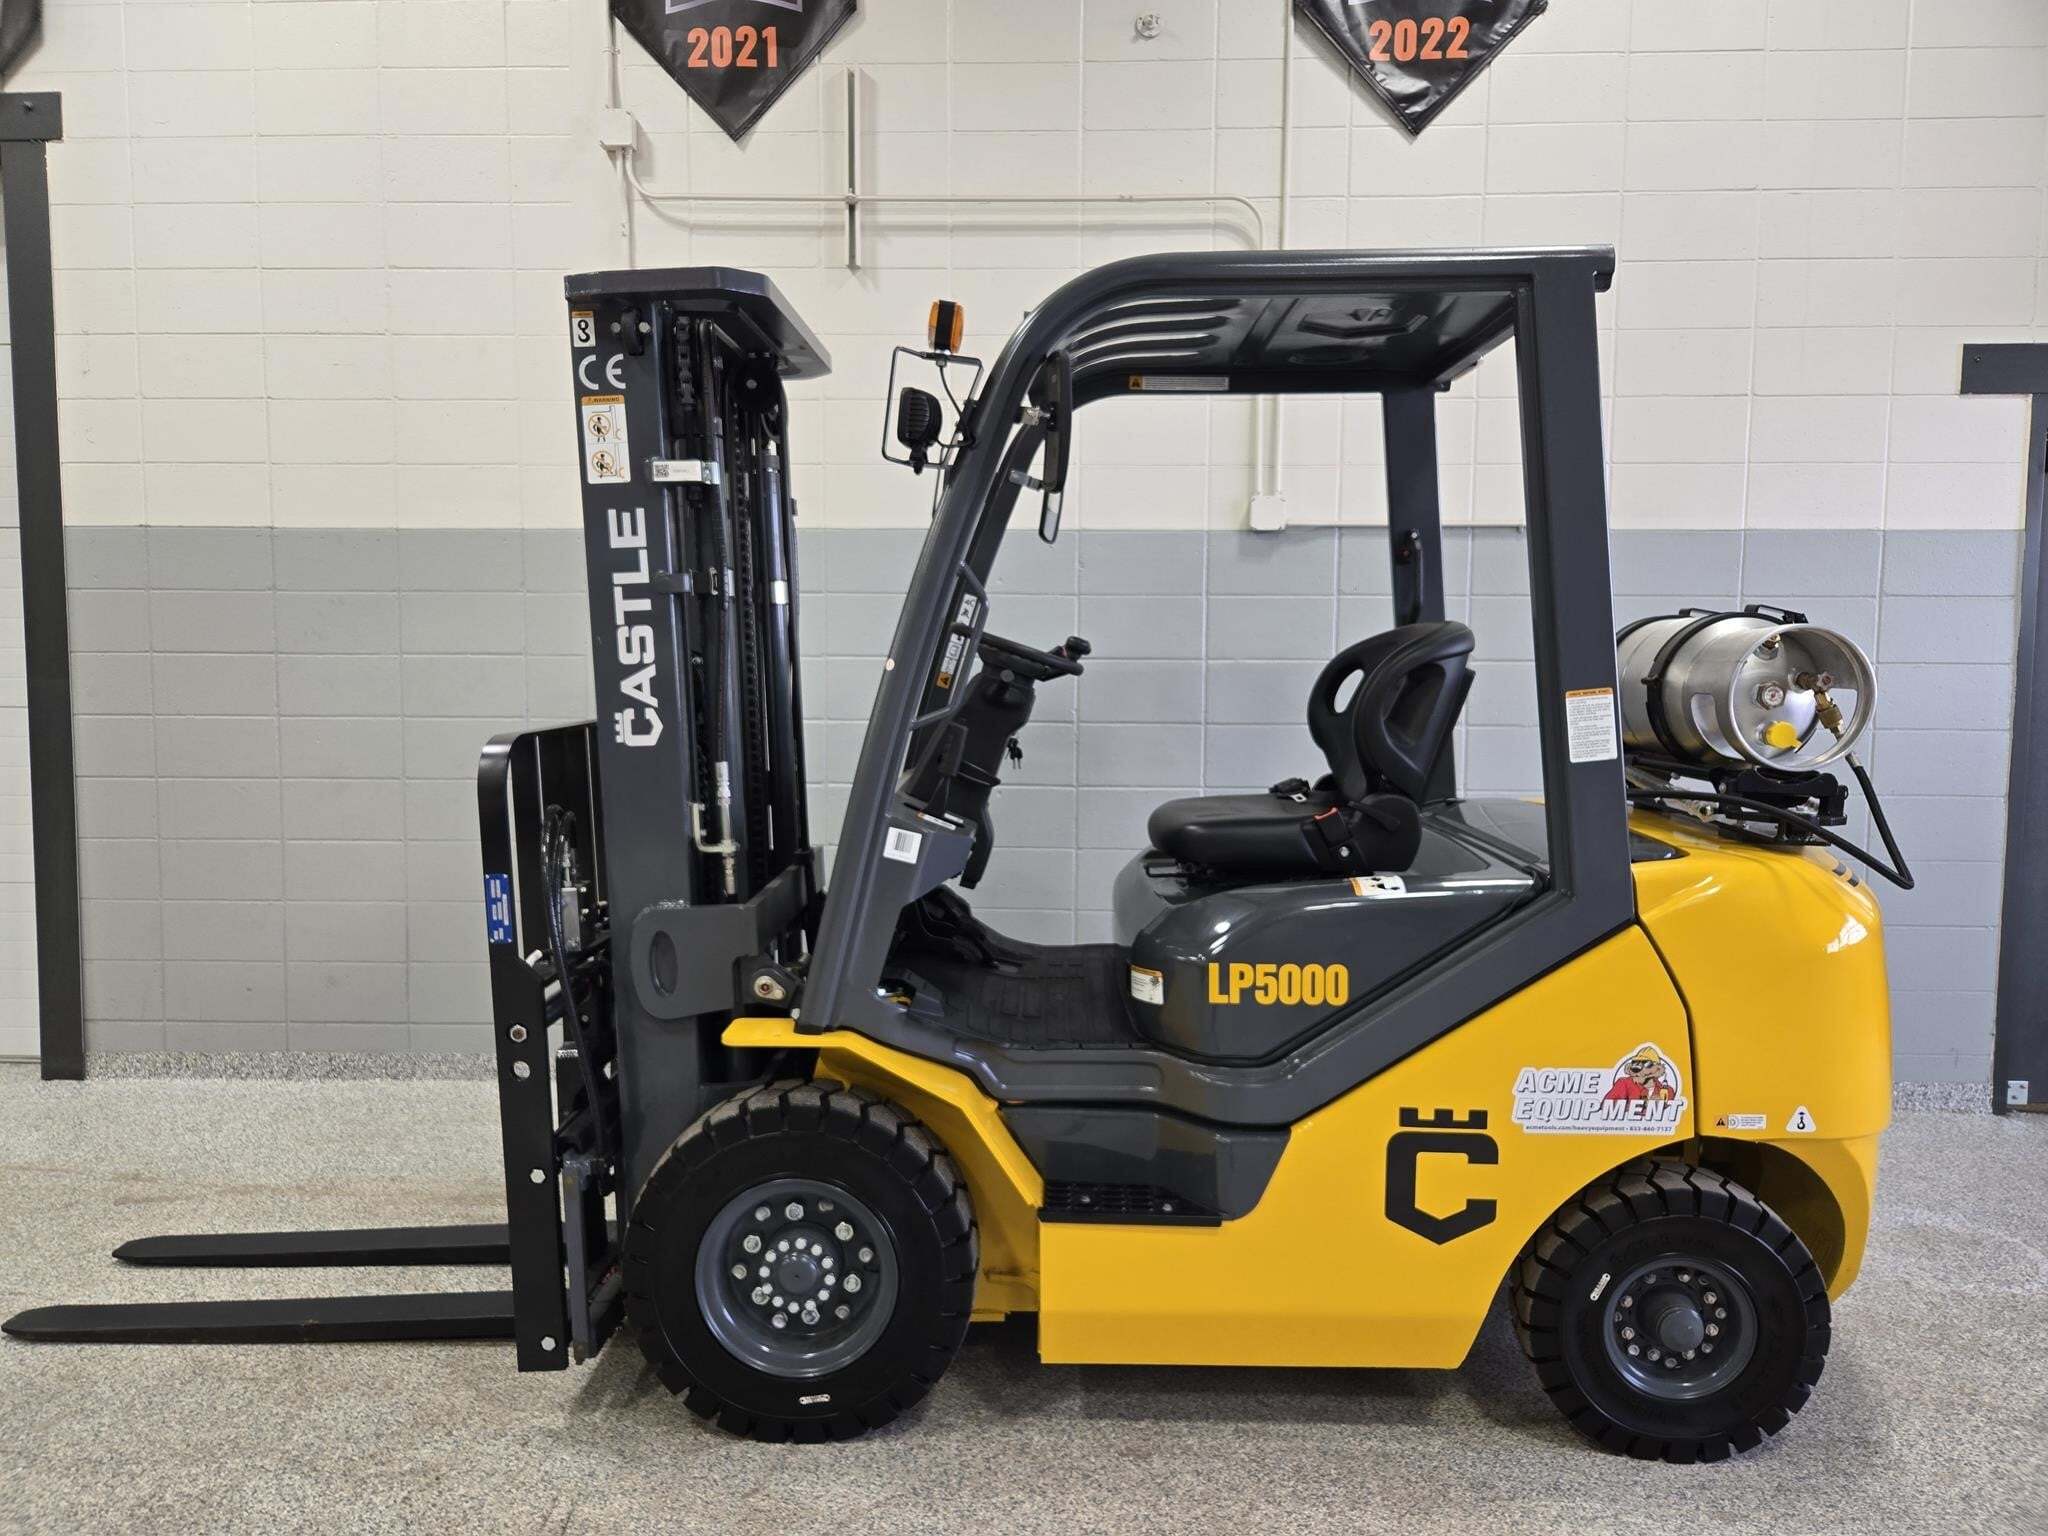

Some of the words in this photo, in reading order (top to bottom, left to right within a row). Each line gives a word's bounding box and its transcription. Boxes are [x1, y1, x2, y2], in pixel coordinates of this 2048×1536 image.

[686, 25, 779, 68] 2021
[1368, 16, 1471, 62] 2022
[578, 353, 627, 390] CE
[607, 507, 664, 748] CASTLE
[1207, 962, 1350, 1006] LP5000
[1516, 1070, 1601, 1094] ACME
[1516, 1097, 1684, 1123] EQUIPMENT
